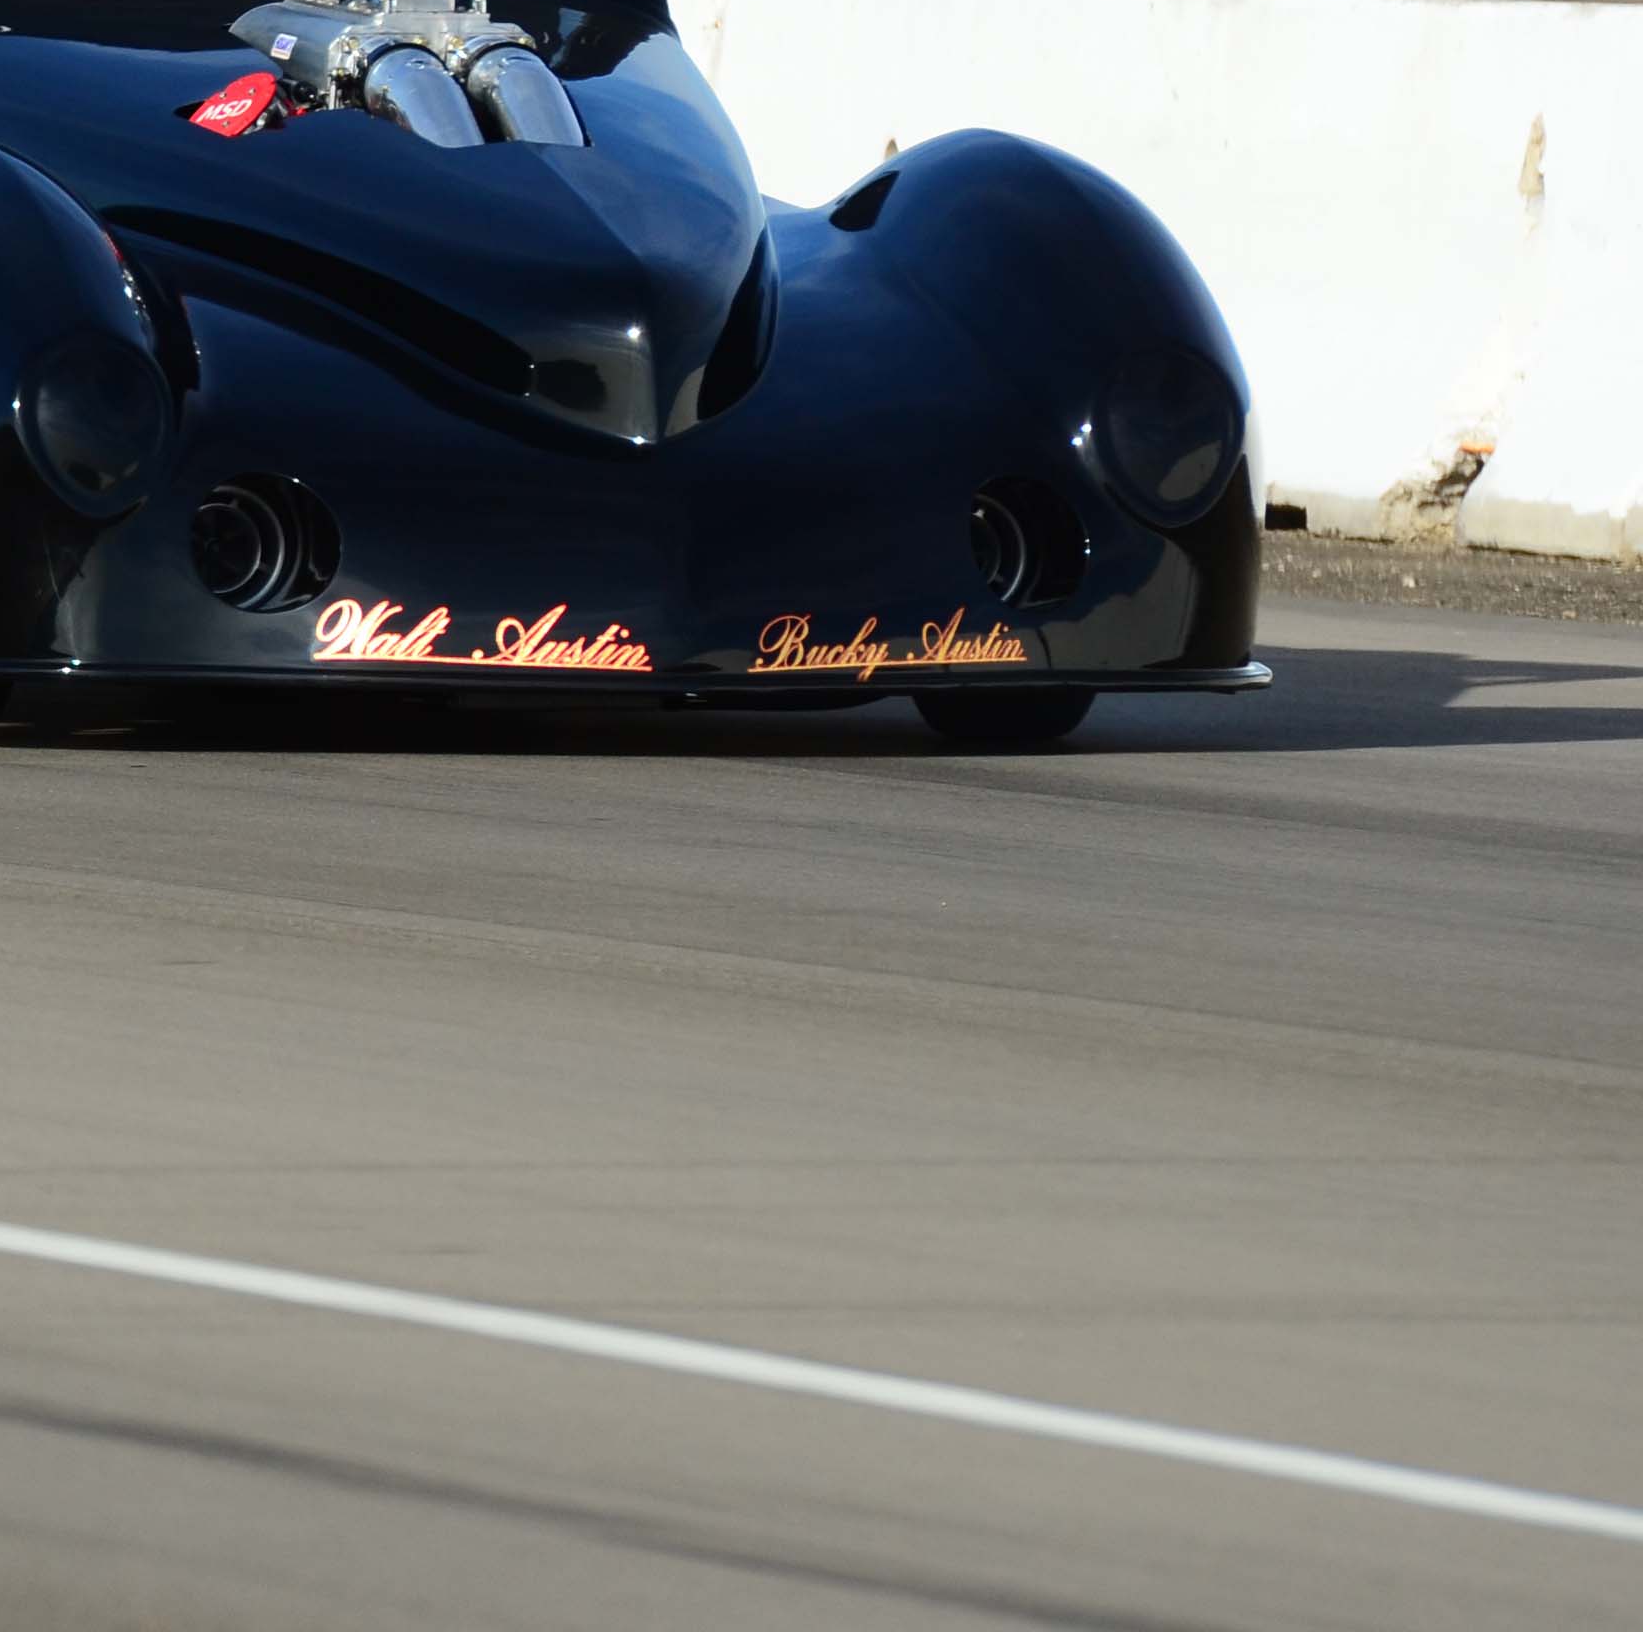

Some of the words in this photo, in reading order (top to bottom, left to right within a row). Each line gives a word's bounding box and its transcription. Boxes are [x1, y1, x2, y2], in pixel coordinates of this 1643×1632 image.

[196, 99, 253, 122] MSD
[315, 598, 452, 659] Walt
[471, 603, 652, 670] Austin
[748, 613, 889, 681] Bucky
[907, 606, 1027, 661] Austin
